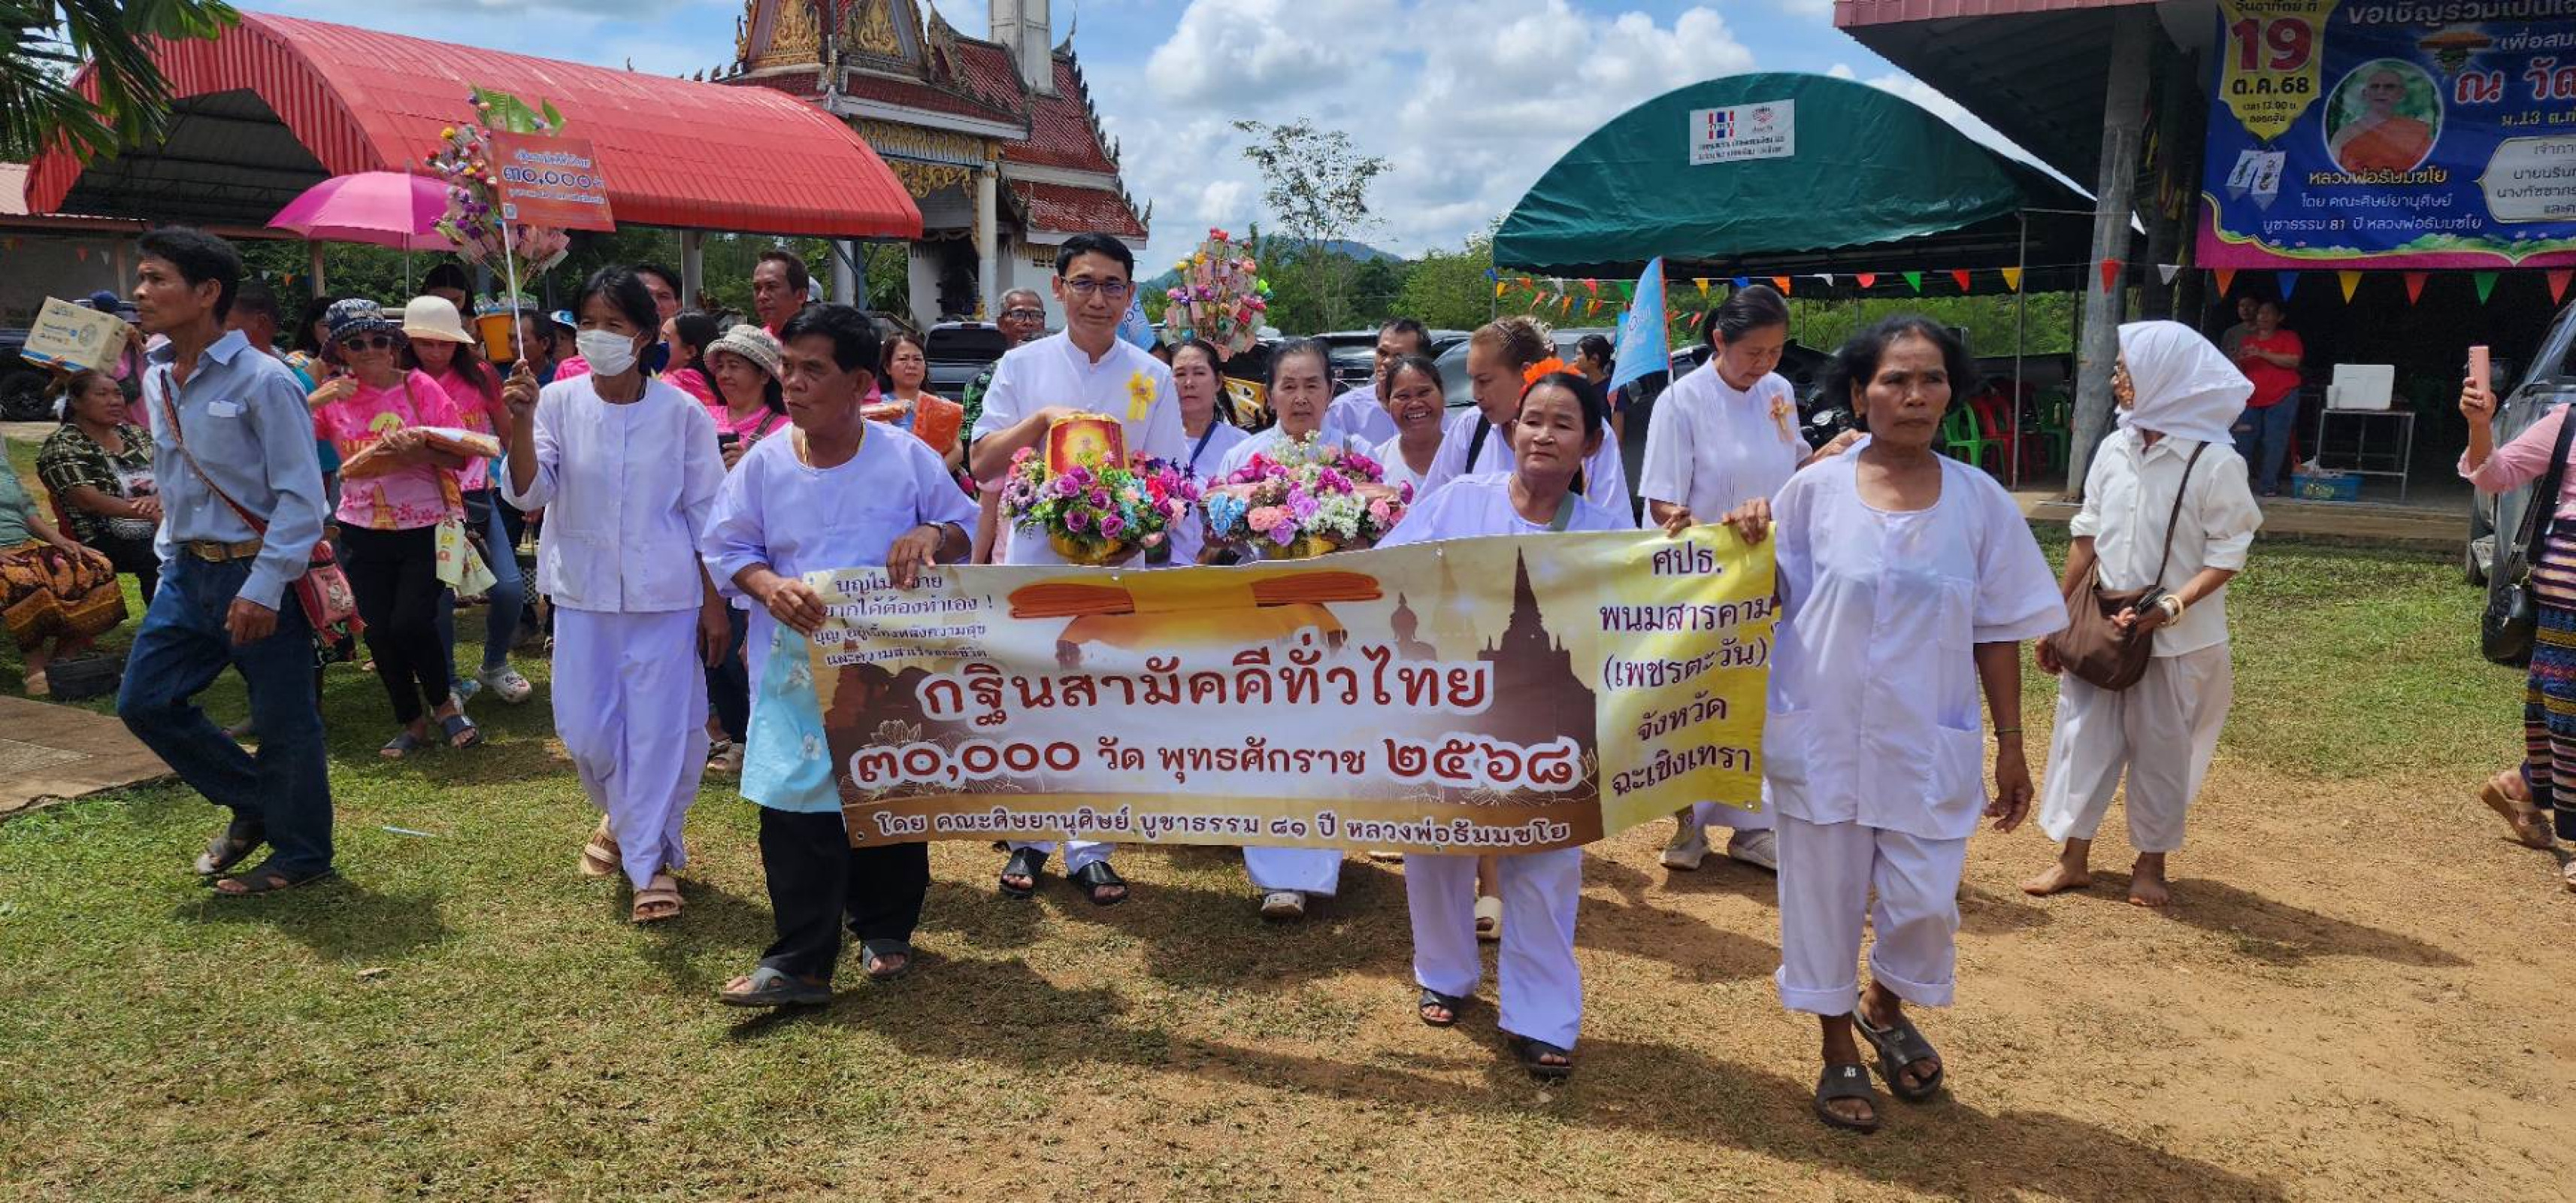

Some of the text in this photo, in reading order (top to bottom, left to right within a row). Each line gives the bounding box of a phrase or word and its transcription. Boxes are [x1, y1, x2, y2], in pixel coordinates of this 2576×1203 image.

[2232, 17, 2312, 71] 19
[2501, 27, 2576, 50] เพื่อสม
[2232, 77, 2310, 95] ต.ค.68
[2456, 71, 2504, 103] ณ
[2329, 218, 2344, 230] 81
[1654, 541, 1721, 575] ศปธ.
[825, 595, 977, 618] ยากได้ต้องทำเอง
[1600, 598, 1772, 631] พนมสารคาม
[924, 632, 1487, 726] กฐินสามัคคีทั่วไทย
[1604, 637, 1766, 691] (เพชรตะวัน)
[1638, 689, 1727, 741] จังหวัด
[858, 735, 1573, 784] ๓๐,๐๐๐ วัด พุทธศักราช ๒๕๖๘
[1612, 744, 1750, 795] ฉะเชิงเทรา
[877, 807, 1570, 845] โดย คณะศิษยานุศิษย์ บูชาธรรม ๘๑ ปี หลวงพ่อธัมมชโย
